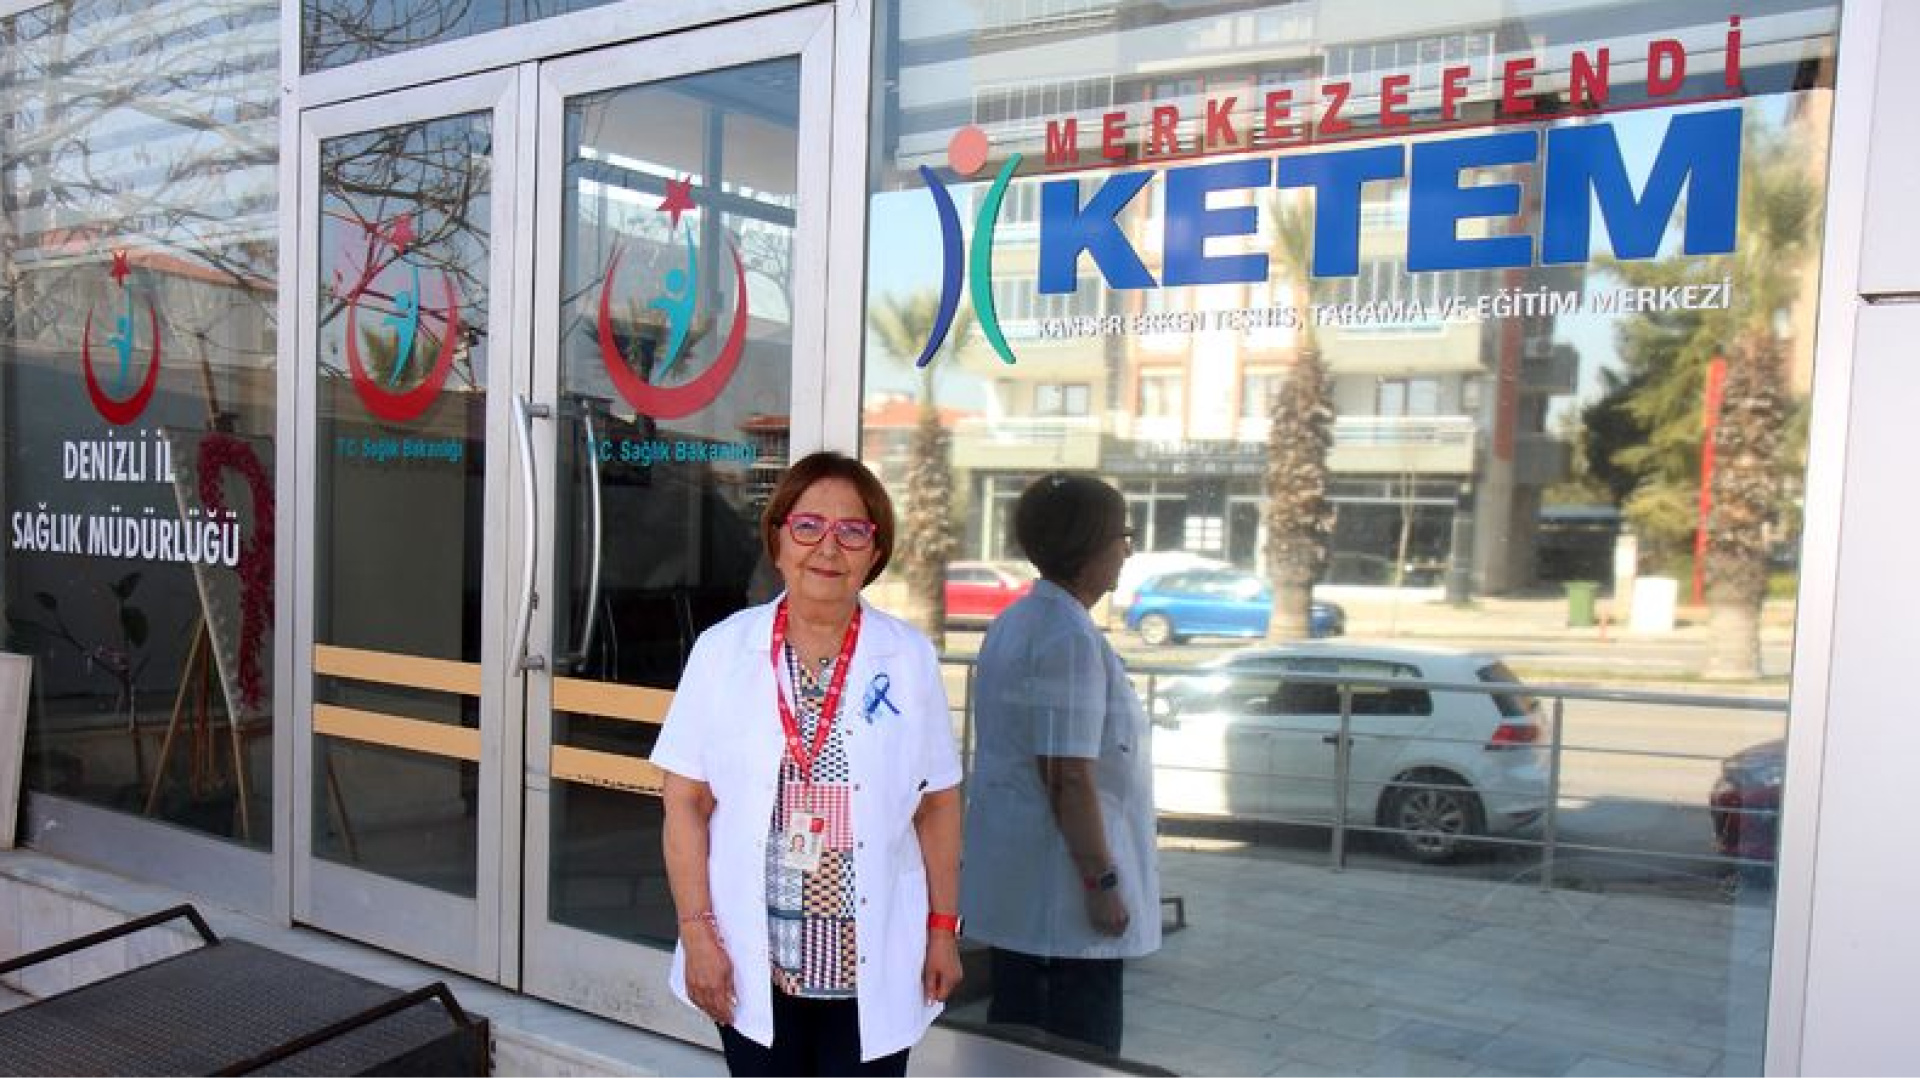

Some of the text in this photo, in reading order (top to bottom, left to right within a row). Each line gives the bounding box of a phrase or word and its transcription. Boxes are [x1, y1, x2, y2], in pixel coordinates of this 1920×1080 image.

[1045, 15, 1744, 166] MERKEZEFENDİ
[1037, 106, 1743, 295] KETEM
[1132, 308, 1207, 336] ERKEN
[1312, 301, 1427, 329] TARAMA
[1439, 296, 1471, 321] VE
[1474, 286, 1580, 319] EĞİTİM
[1590, 277, 1732, 316] MERKEZİ
[62, 428, 176, 484] DENİZLİ İL
[619, 438, 669, 467] Sağlık
[11, 502, 241, 567] SAĞLIK MÜDÜRLÜĞÜ
